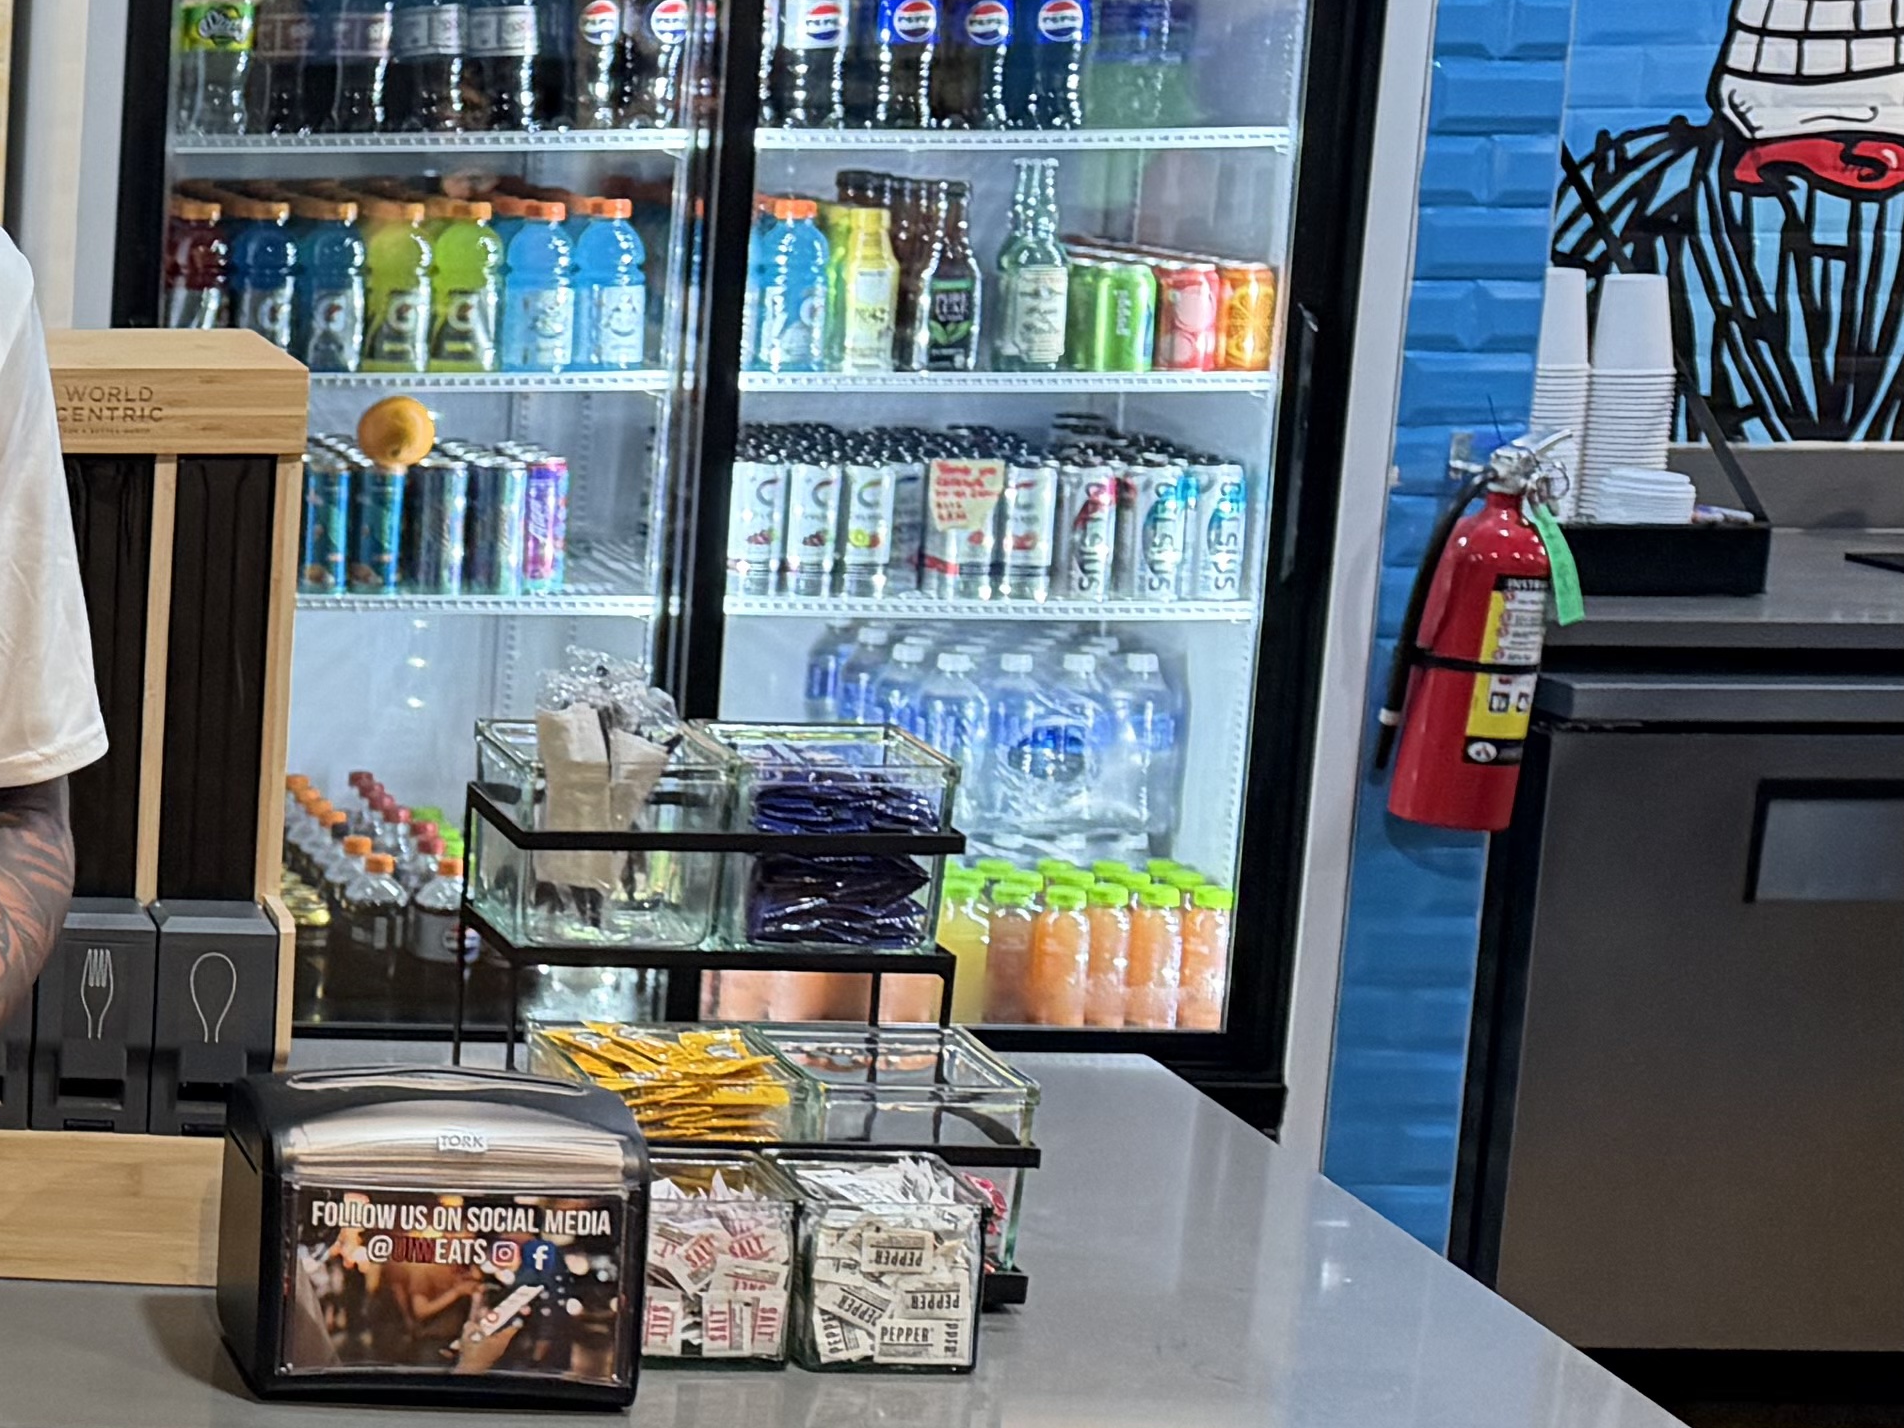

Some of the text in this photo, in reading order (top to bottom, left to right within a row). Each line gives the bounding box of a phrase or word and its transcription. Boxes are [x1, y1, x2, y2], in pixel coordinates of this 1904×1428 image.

[64, 385, 154, 403] WORLD
[55, 406, 164, 423] CENTRIC
[439, 1134, 485, 1150] TORK
[311, 1200, 612, 1236] FOLLOW US ON SOCIAL MEDIA
[873, 1248, 924, 1268] PEPPER
[910, 1293, 961, 1311] PEPPER
[650, 1304, 671, 1342] SALT
[708, 1307, 728, 1342] SALT
[757, 1306, 778, 1342] SALT
[880, 1326, 930, 1343] PEPPER
